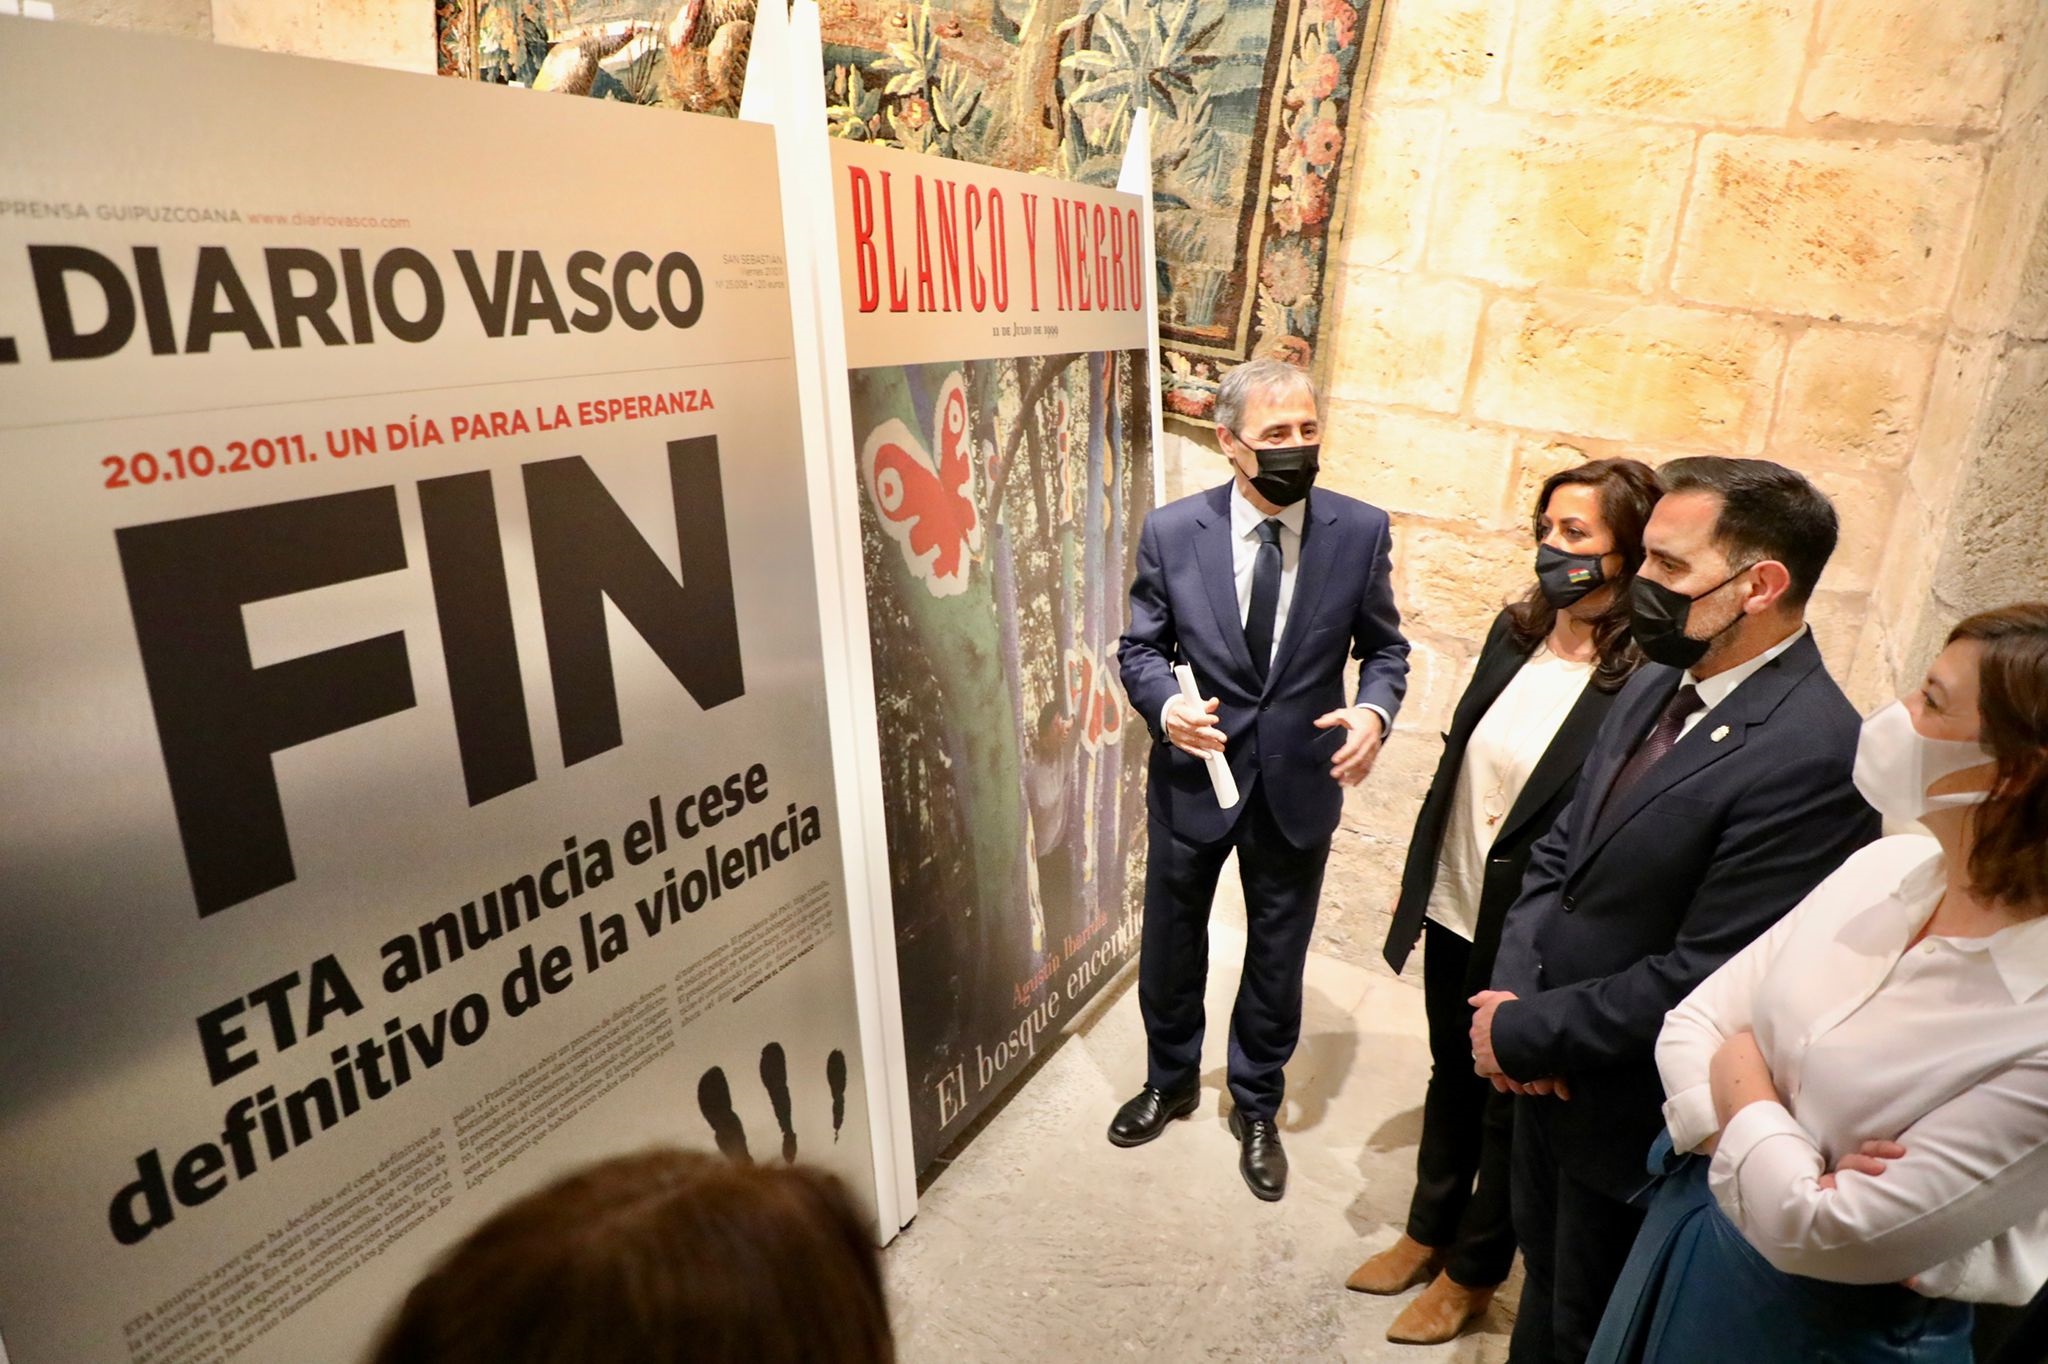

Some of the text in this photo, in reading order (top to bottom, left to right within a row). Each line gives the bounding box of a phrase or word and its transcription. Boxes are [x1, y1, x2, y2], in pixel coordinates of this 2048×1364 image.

[0, 201, 411, 229] PRENSA GUIPUZCOANA www.diariovasco.com
[848, 165, 1142, 313] BLANCO Y NEGRO
[27, 244, 704, 362] DIARIO VASCO
[1044, 325, 1059, 339] 1999
[101, 388, 715, 489] 20.10.2011. UN DÍA PARA LA ESPERANZA
[114, 434, 745, 919] FIN
[196, 954, 365, 1087] ETA
[380, 835, 615, 993] anuncia
[623, 795, 667, 867] el
[676, 762, 769, 840] cese
[109, 993, 489, 1246] definitivo
[502, 944, 574, 1018] de
[580, 911, 629, 974] la
[635, 802, 822, 939] violencia
[935, 901, 1144, 1131] El bosque encendi
